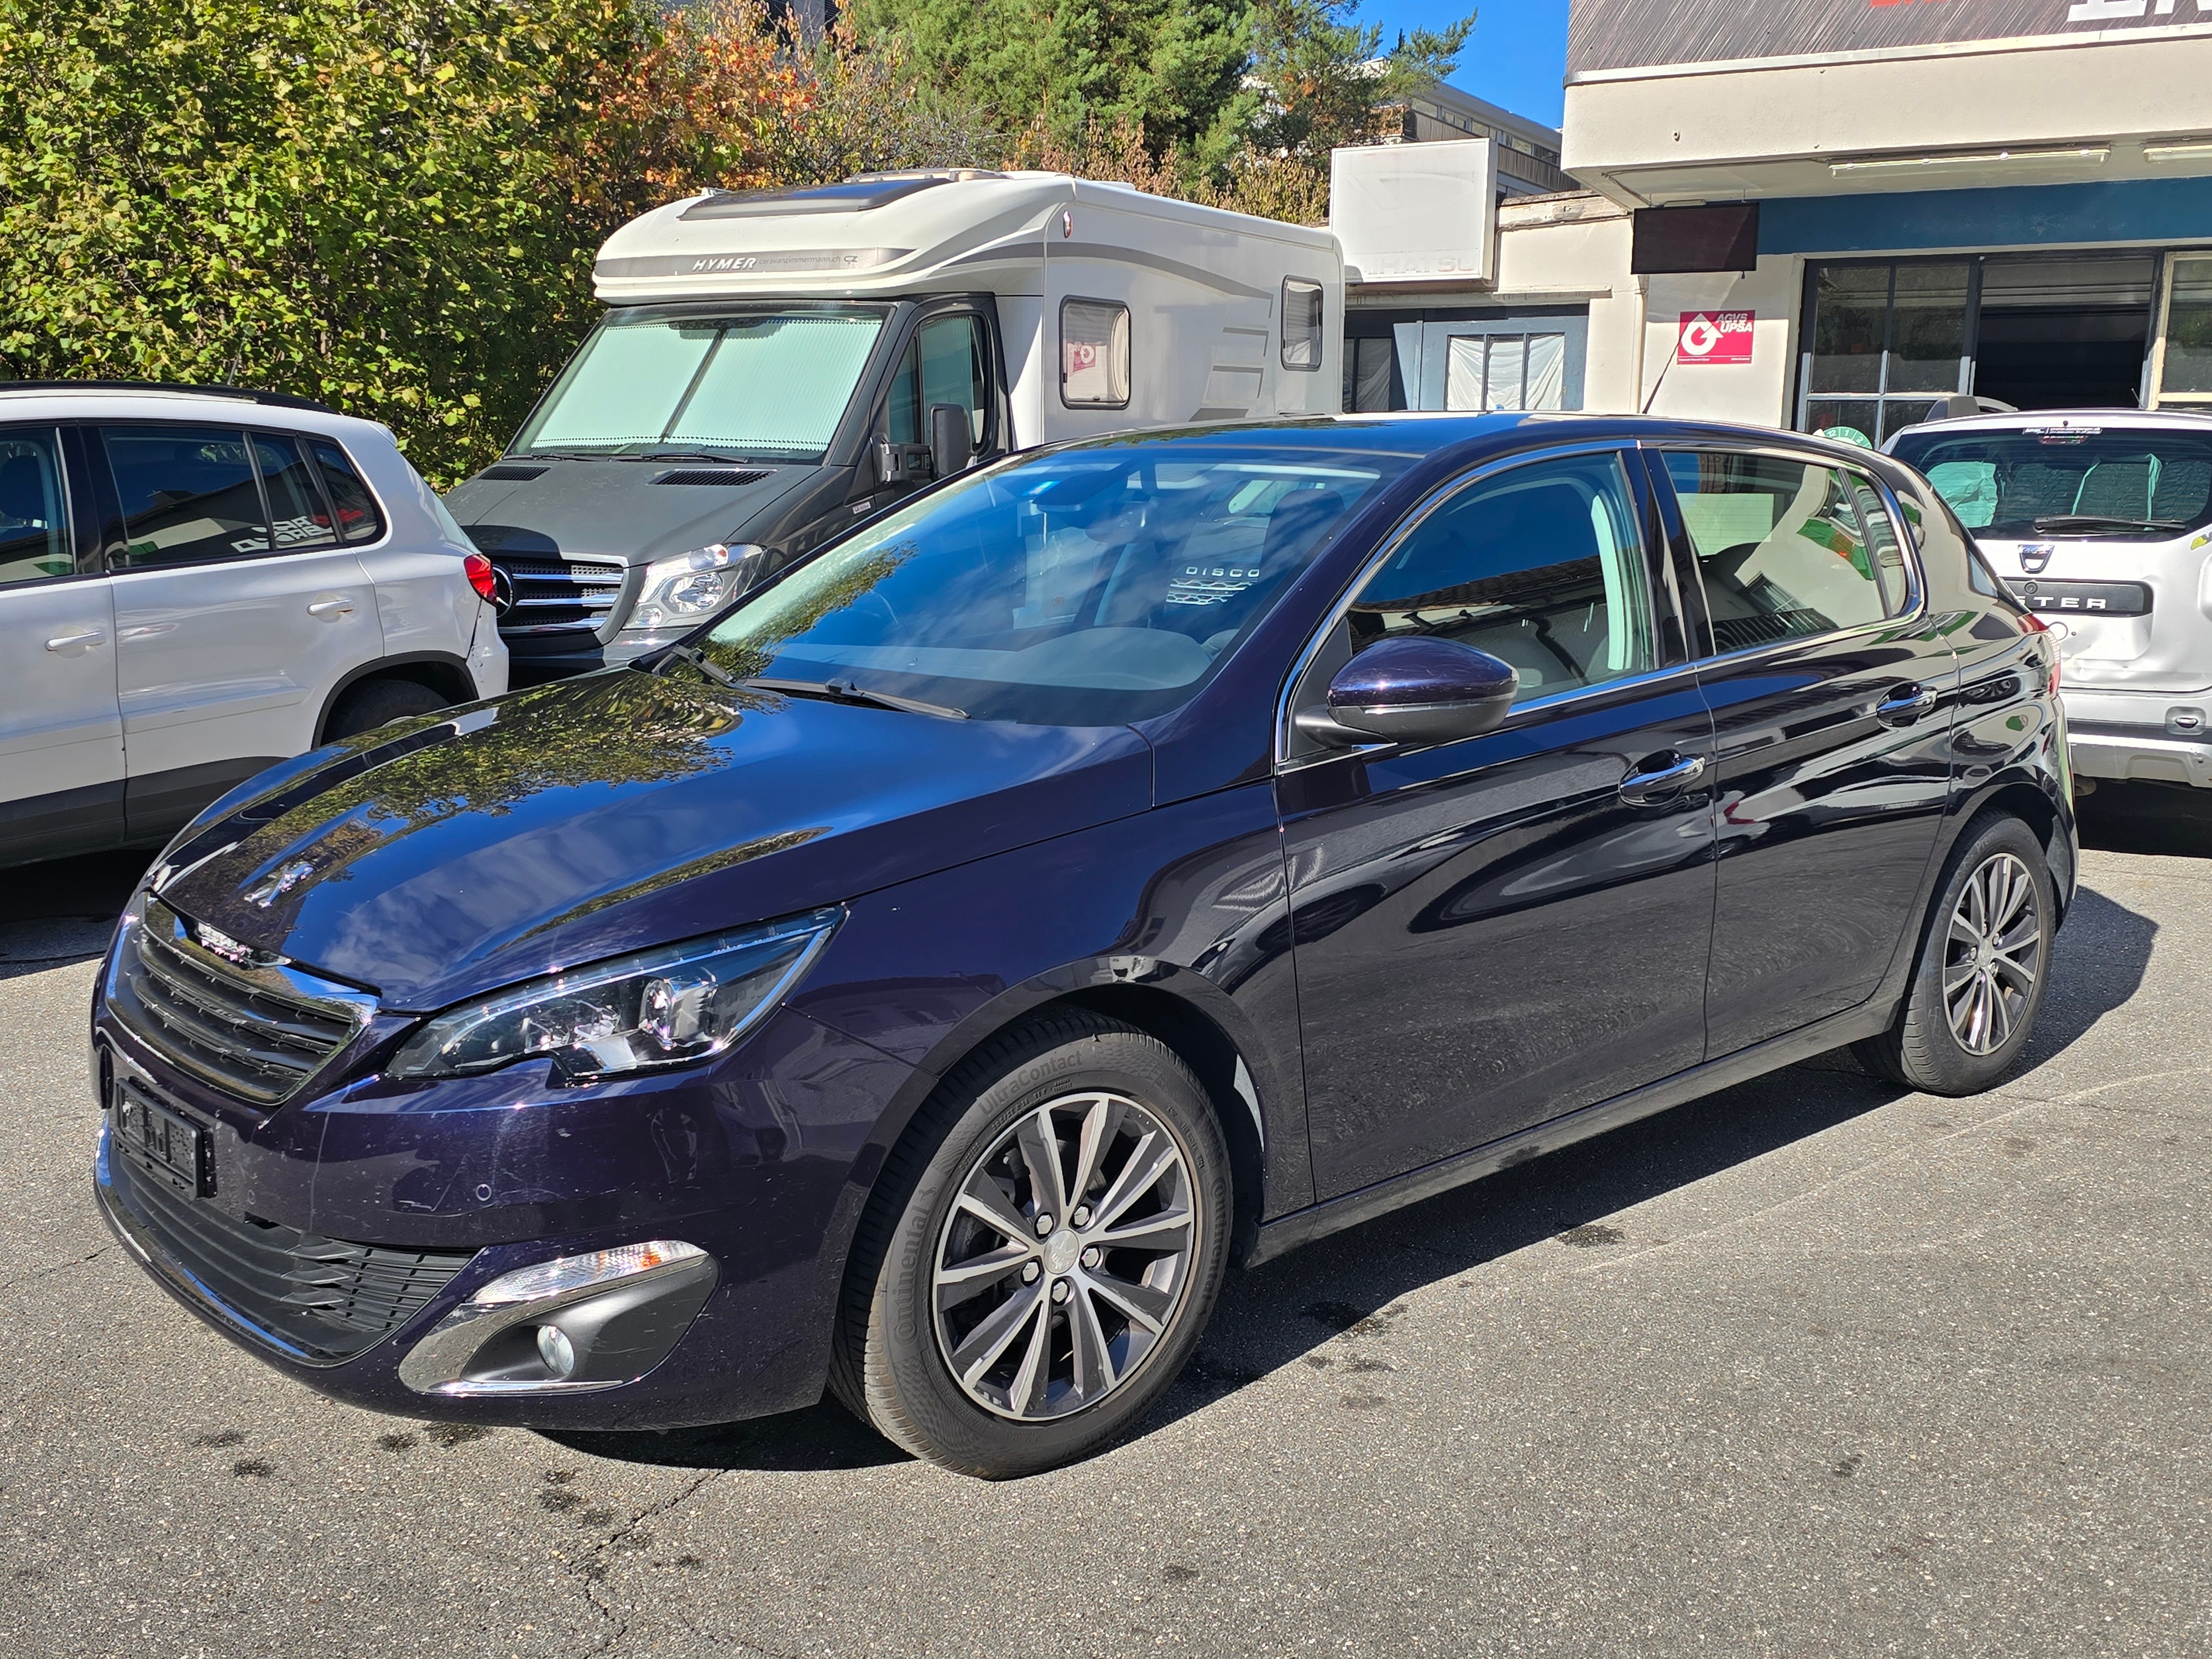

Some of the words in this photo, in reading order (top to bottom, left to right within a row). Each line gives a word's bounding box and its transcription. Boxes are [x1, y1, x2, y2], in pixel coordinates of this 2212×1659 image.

[692, 257, 757, 272] HYMER
[759, 255, 841, 265] caravanzimmermann.ch
[1715, 314, 1748, 324] AGVS
[1720, 321, 1752, 333] UPSA
[978, 1051, 1083, 1115] UltraContact
[894, 1205, 931, 1345] Continental
